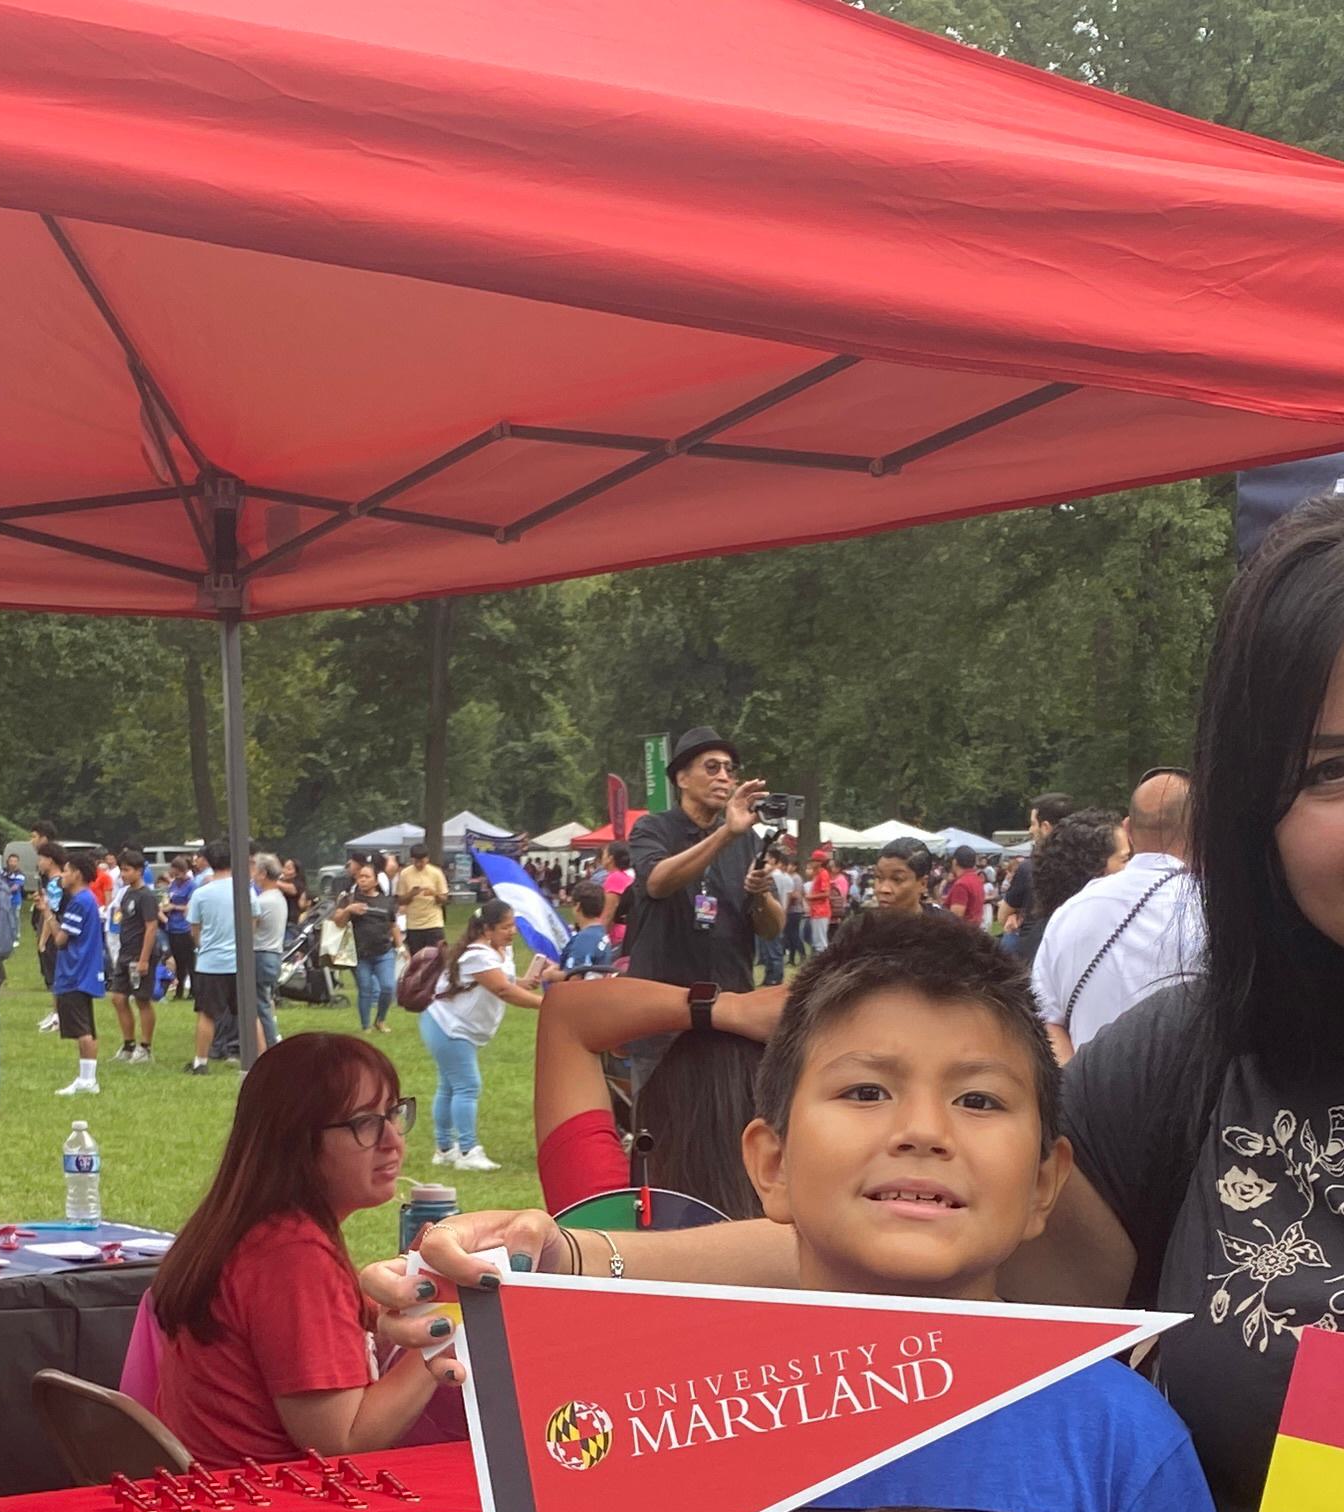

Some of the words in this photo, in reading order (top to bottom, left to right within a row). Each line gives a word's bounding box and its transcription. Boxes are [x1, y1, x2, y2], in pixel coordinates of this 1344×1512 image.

[624, 1342, 879, 1413] UNIVERSITY
[899, 1330, 945, 1356] OF
[629, 1358, 954, 1457] MARYLAND
